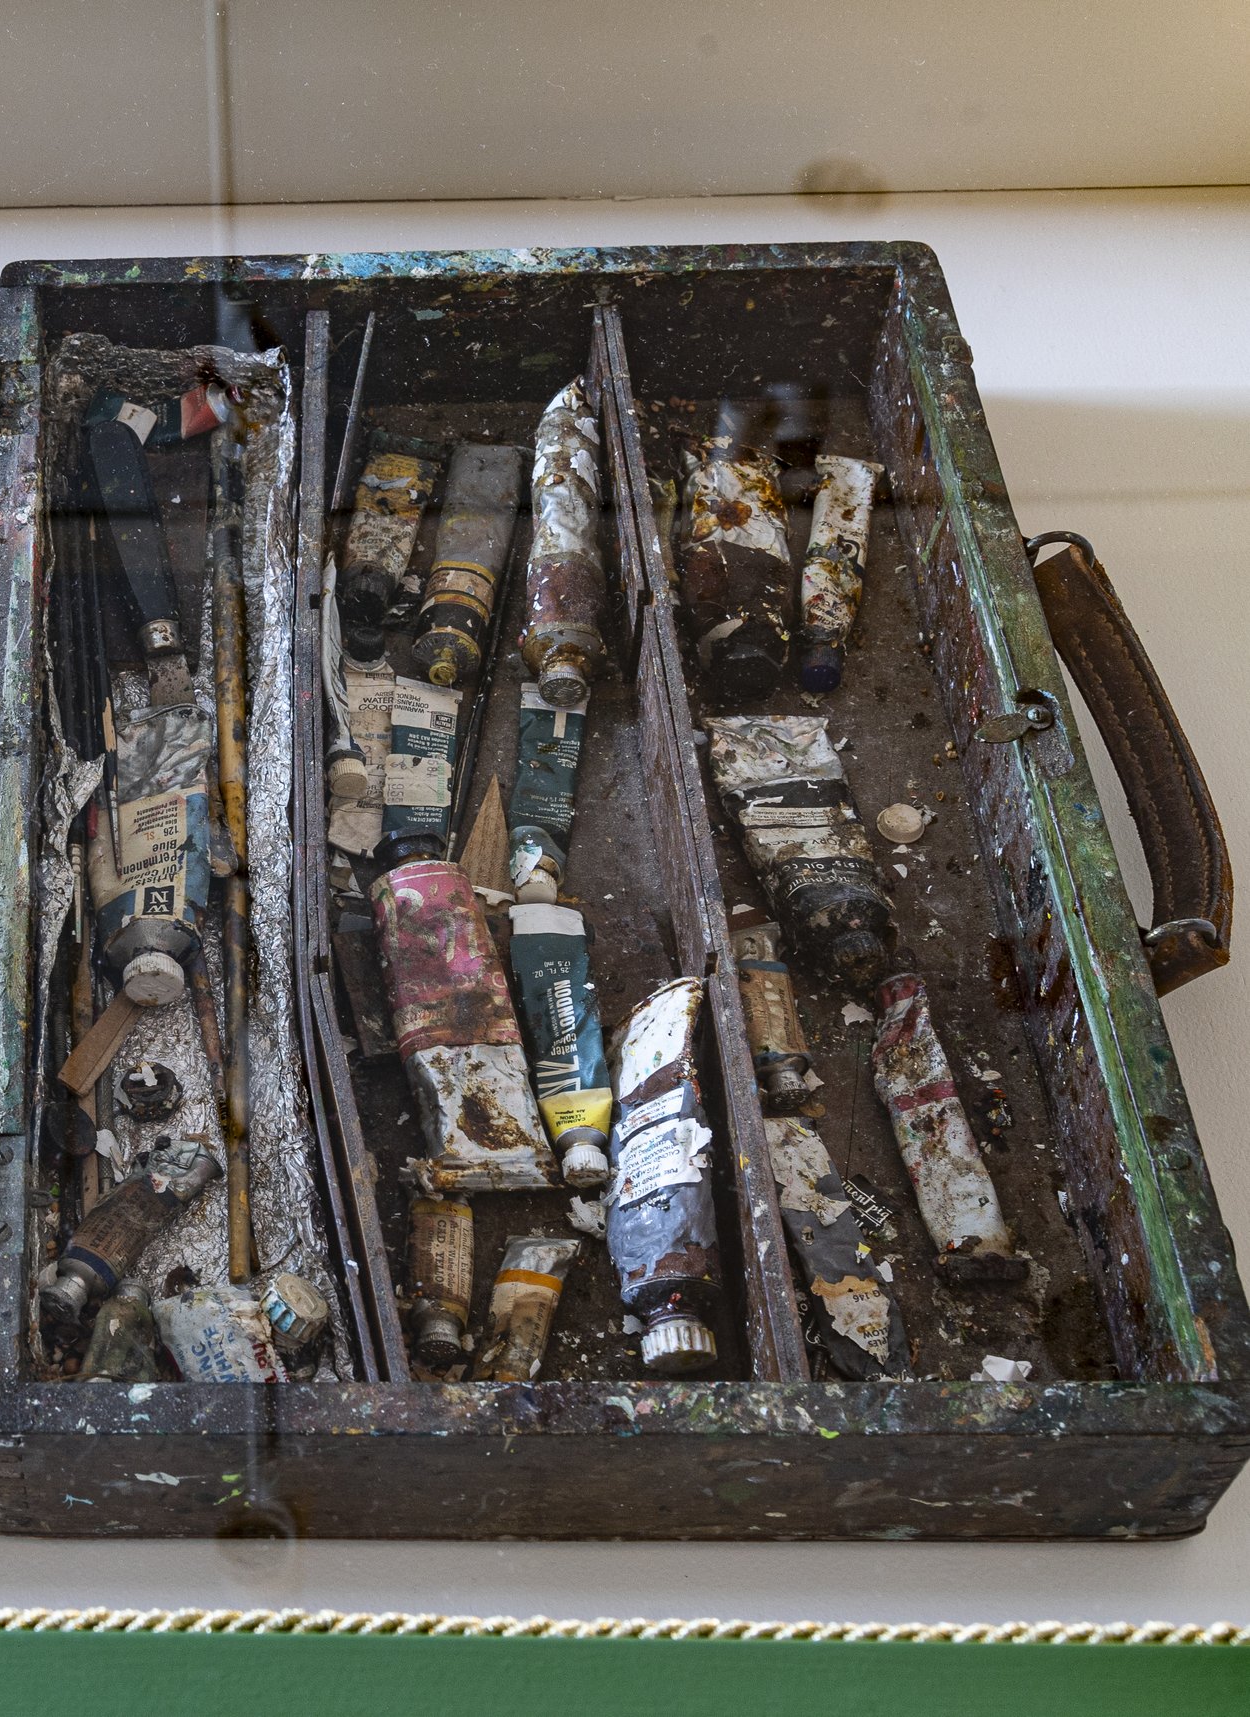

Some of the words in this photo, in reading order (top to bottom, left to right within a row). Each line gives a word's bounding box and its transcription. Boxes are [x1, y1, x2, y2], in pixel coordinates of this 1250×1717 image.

[396, 693, 420, 701] PHENOL
[394, 704, 424, 713] WARNING
[397, 699, 428, 708] CONTAINS
[430, 731, 449, 739] England
[162, 825, 179, 836] 126
[151, 839, 178, 853] Blue
[116, 850, 178, 877] Permanen
[121, 868, 159, 885] Colour
[129, 871, 176, 889] Artists'
[147, 891, 170, 903] N
[145, 904, 169, 912] W
[553, 979, 575, 1035] LONDON
[550, 1043, 577, 1056] water
[556, 1117, 586, 1127] CADMIUM
[436, 1219, 445, 1247] CAD.
[460, 1228, 468, 1260] London,
[852, 1291, 870, 1303] 146
